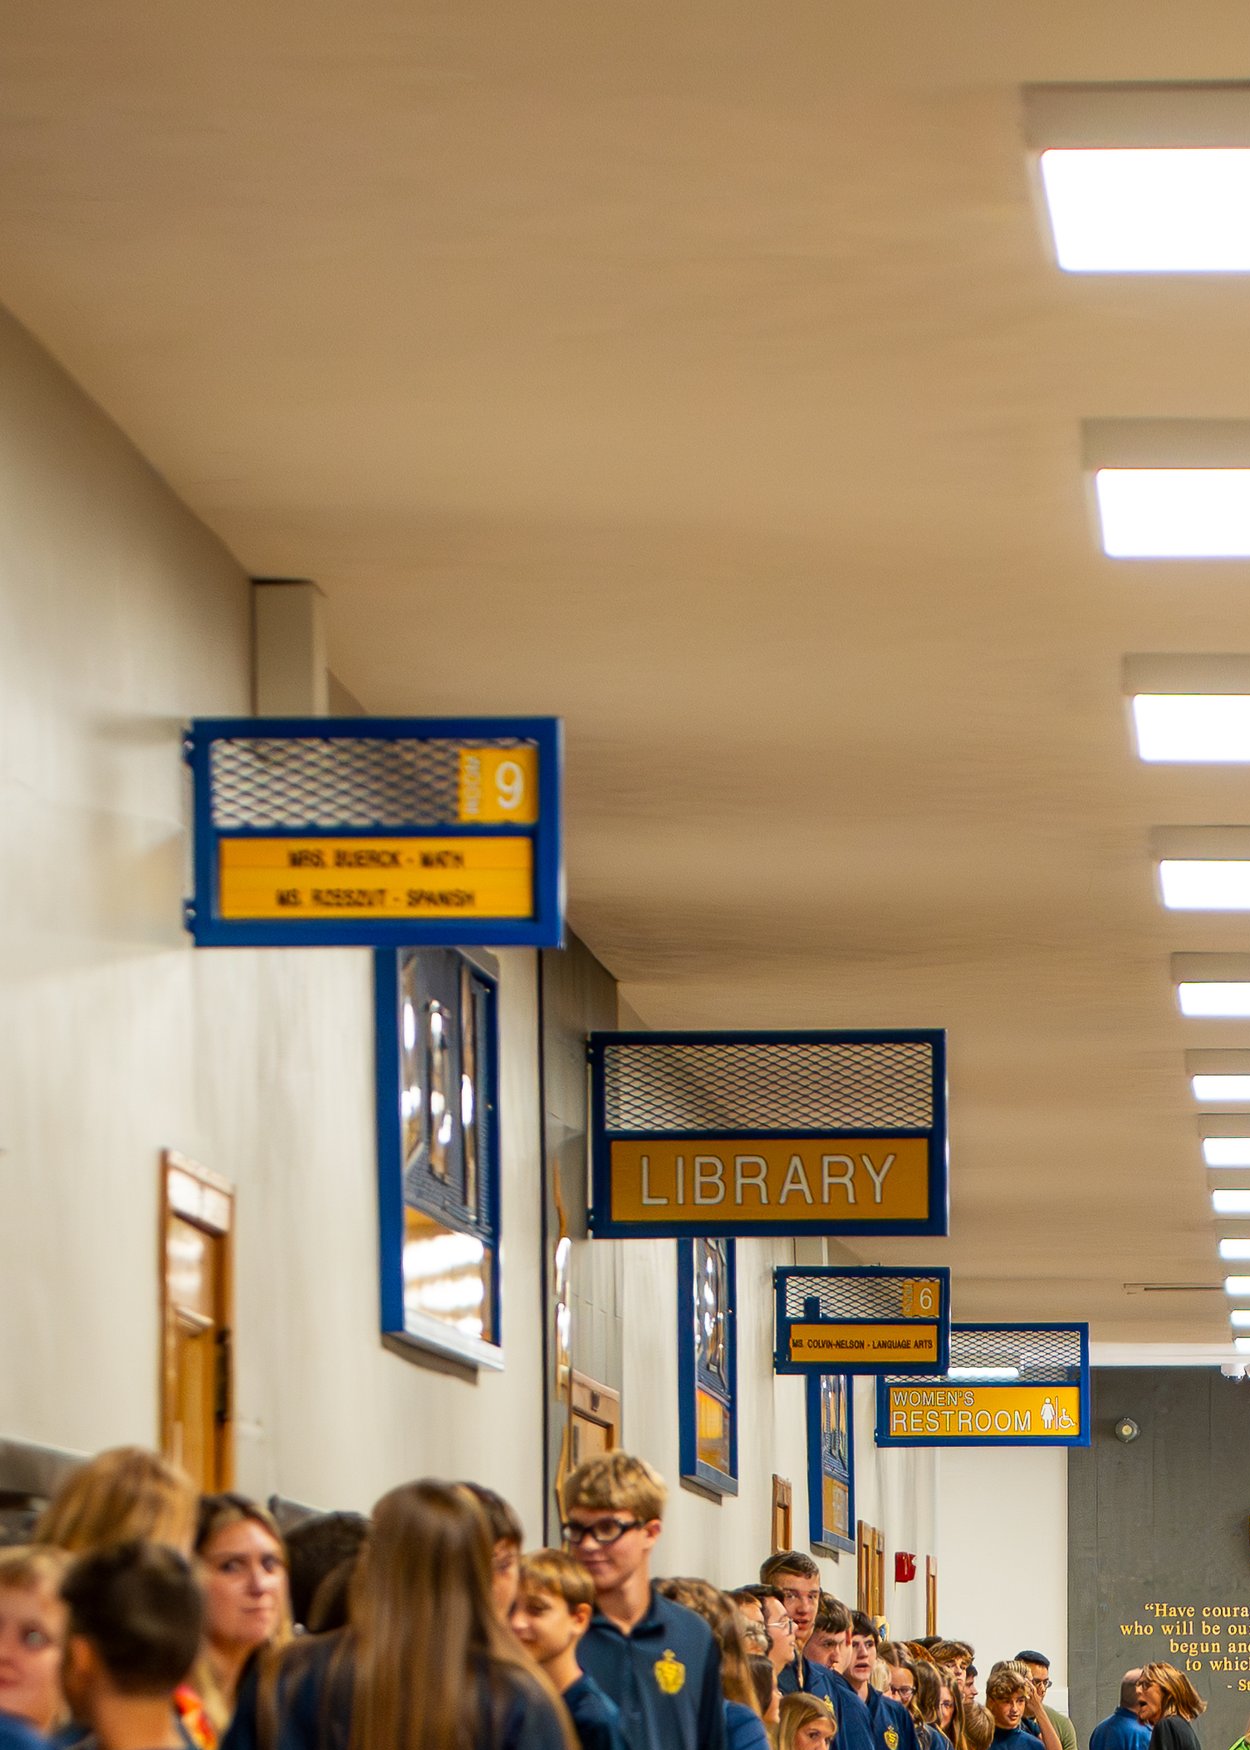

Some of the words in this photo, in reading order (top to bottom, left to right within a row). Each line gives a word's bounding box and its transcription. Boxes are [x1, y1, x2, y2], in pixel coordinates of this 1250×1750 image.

[496, 761, 524, 810] 9
[420, 850, 464, 868] MATH
[640, 1154, 896, 1206] LIBRARY
[919, 1287, 932, 1310] 6
[807, 1339, 865, 1350] COLVIN-NELSON
[872, 1340, 911, 1349] LANGUAGE
[914, 1339, 933, 1349] ARTS
[893, 1391, 975, 1407] WOMEN'S
[892, 1410, 1031, 1432] RESTROOM
[1120, 1621, 1154, 1635] who
[1161, 1621, 1193, 1635] will
[1202, 1621, 1221, 1635] be
[1170, 1638, 1221, 1656] begun
[1186, 1658, 1202, 1671] to
